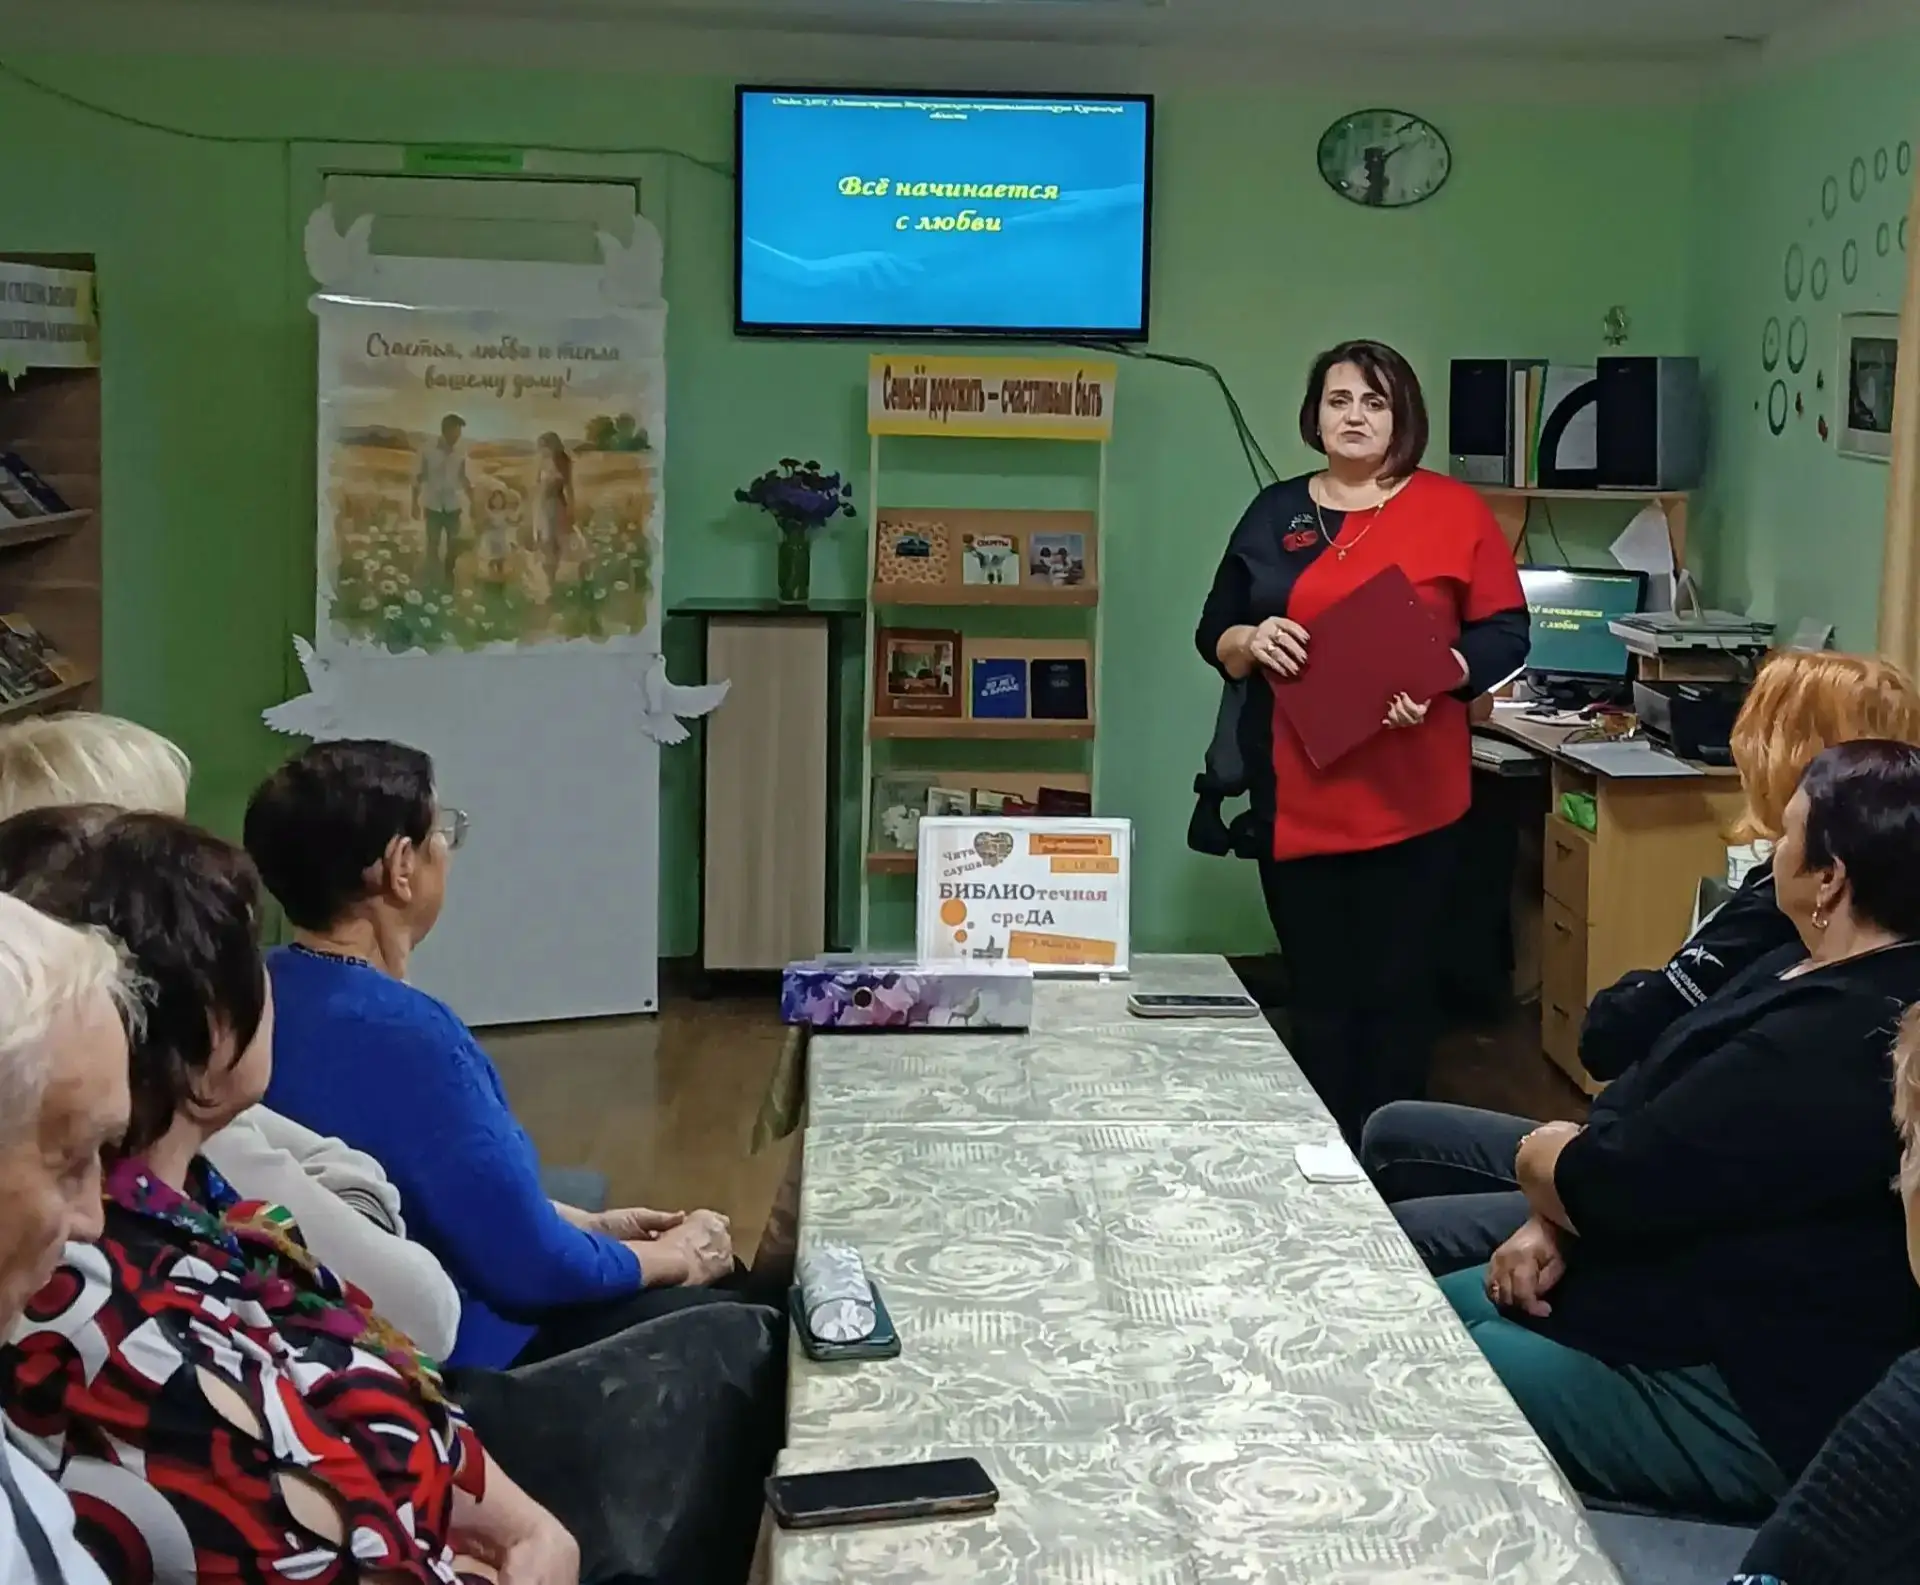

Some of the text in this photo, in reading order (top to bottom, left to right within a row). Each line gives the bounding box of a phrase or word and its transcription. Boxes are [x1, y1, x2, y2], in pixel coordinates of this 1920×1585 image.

[838, 176, 1058, 200] Всё начинается
[895, 209, 1001, 231] с любви
[366, 332, 620, 361] Счастья, любви и тепла
[425, 364, 572, 398] вашему дому!
[938, 882, 1109, 902] БИБЛИОтечная
[991, 909, 1056, 928] среДА
